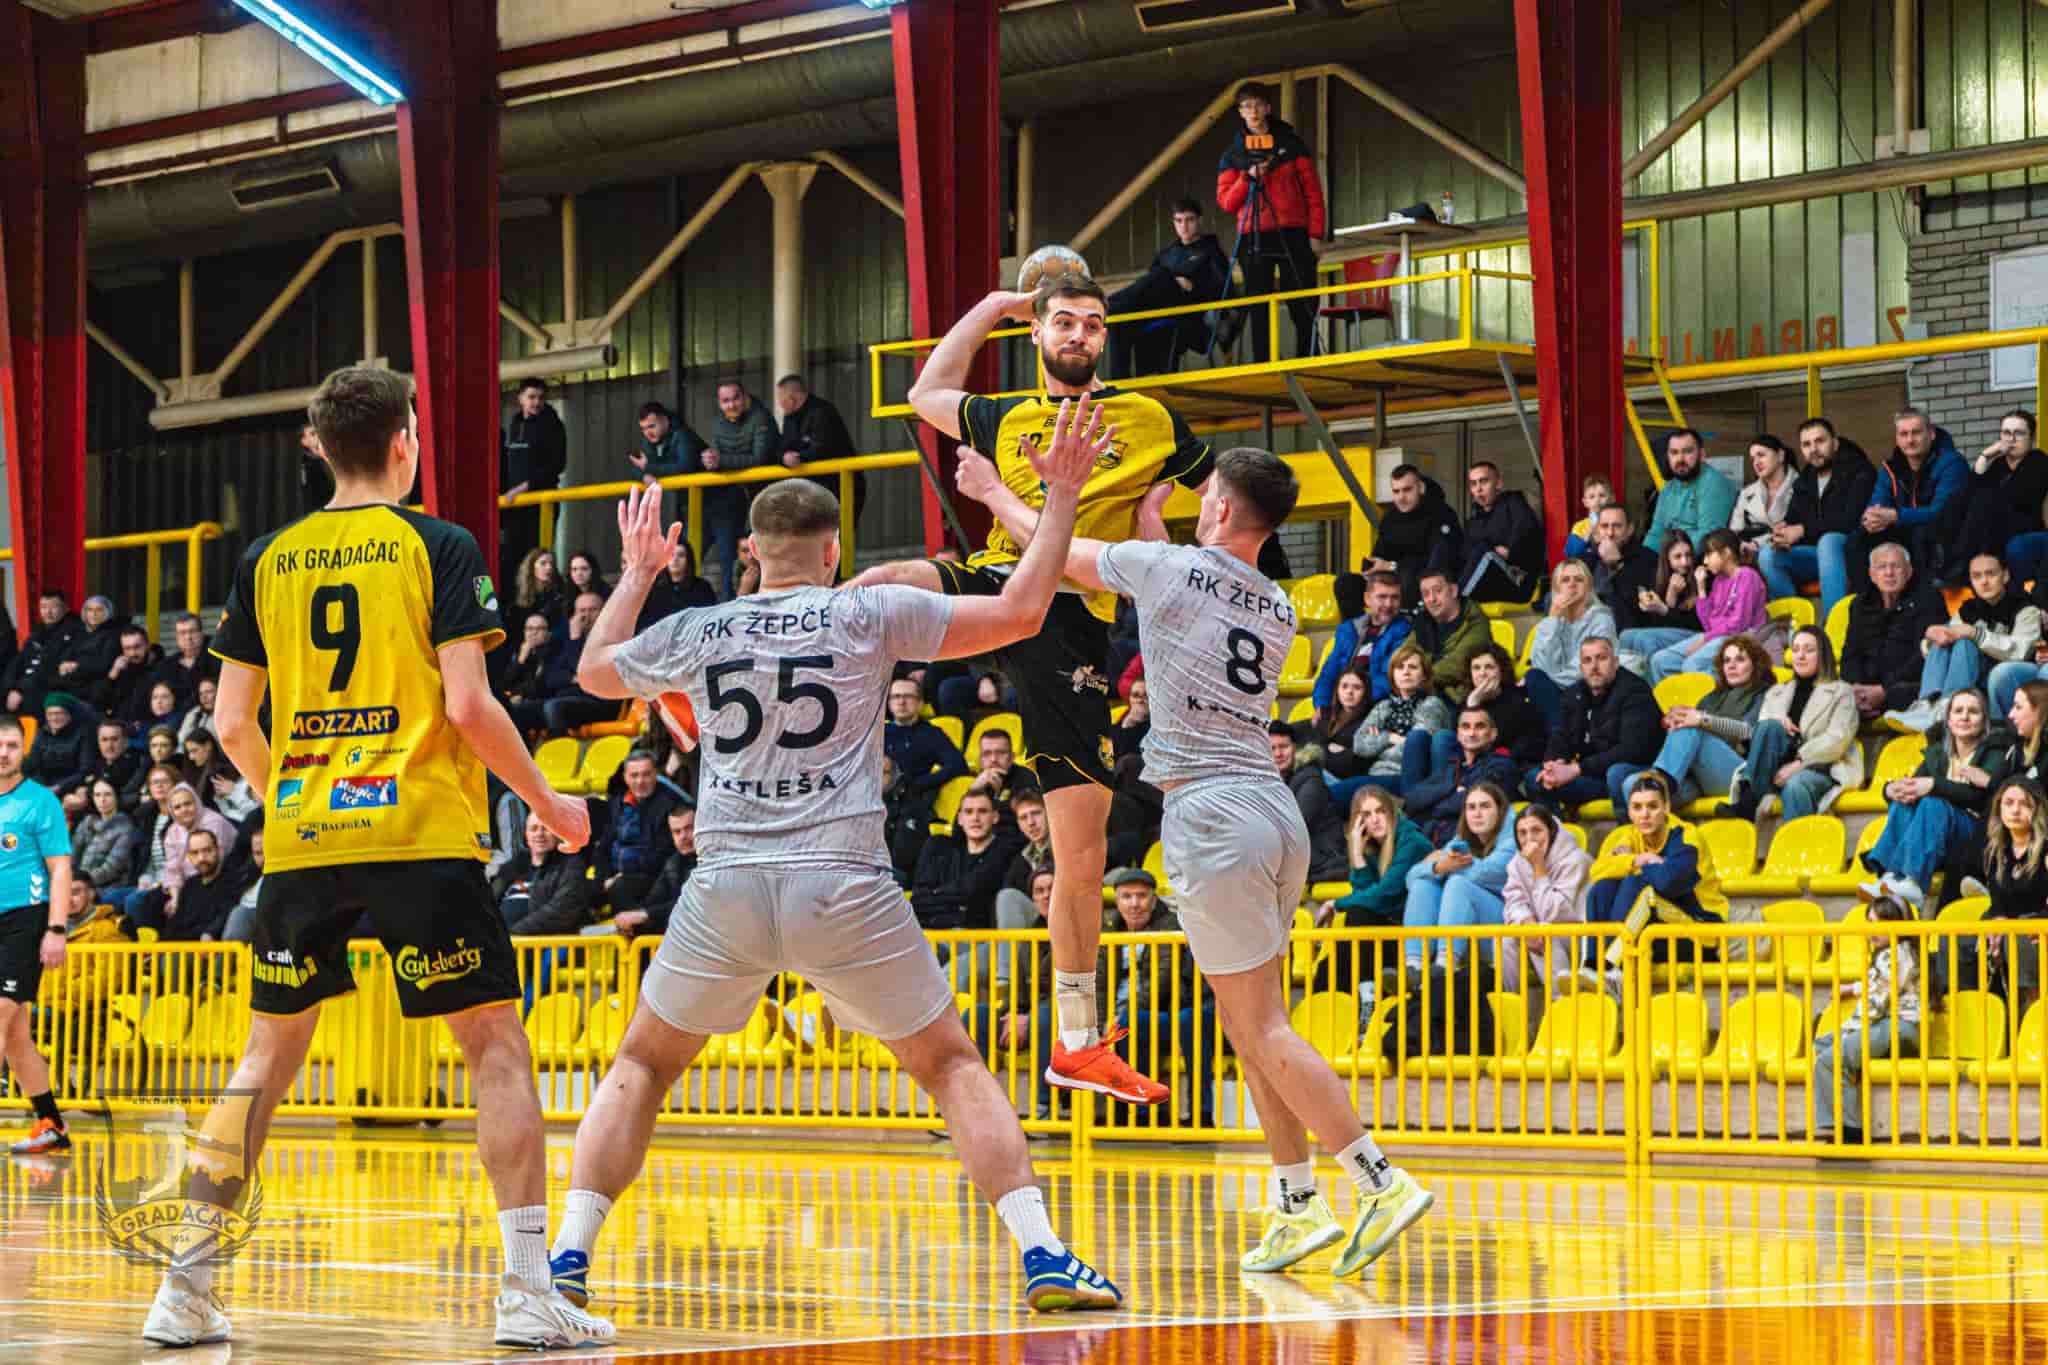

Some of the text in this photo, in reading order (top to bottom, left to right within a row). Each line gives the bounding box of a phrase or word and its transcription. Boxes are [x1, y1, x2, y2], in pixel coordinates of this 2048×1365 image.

[276, 538, 399, 575] RK GRADAČAC
[1187, 568, 1221, 598] RK
[310, 583, 361, 692] 9
[702, 606, 833, 643] RK ŽEPČE
[1226, 627, 1267, 695] 8
[291, 709, 393, 737] MOZZART
[705, 655, 839, 754] 55
[396, 942, 482, 990] Carlsberg
